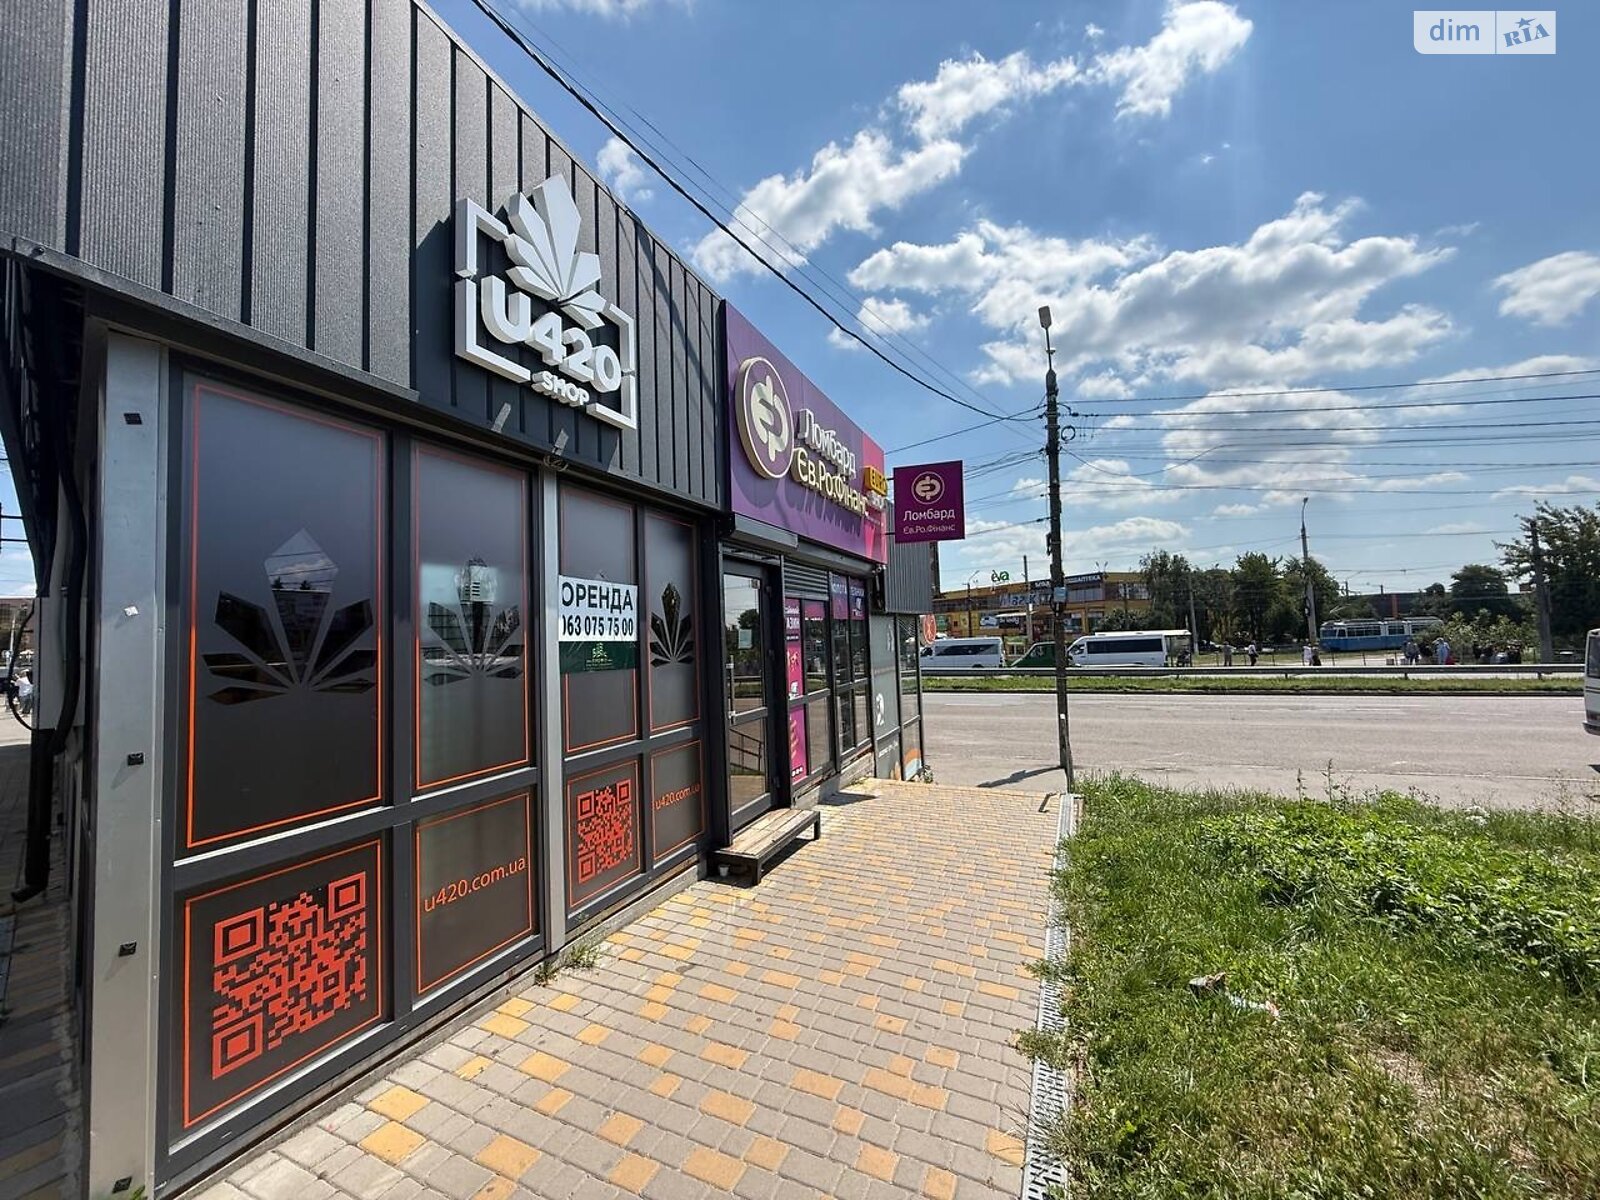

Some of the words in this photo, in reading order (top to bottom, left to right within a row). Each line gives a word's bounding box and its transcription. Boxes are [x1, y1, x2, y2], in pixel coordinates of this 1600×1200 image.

[532, 370, 590, 407] SHOP
[798, 408, 857, 480] Ломбард
[903, 508, 956, 521] Ломбард
[903, 524, 956, 535] Єв.Ро.Фінанс
[562, 582, 633, 614] ОРЕНДА
[584, 616, 605, 636] 075
[607, 617, 620, 636] 75
[621, 618, 634, 636] 00
[423, 856, 526, 913] u420.com.ua
